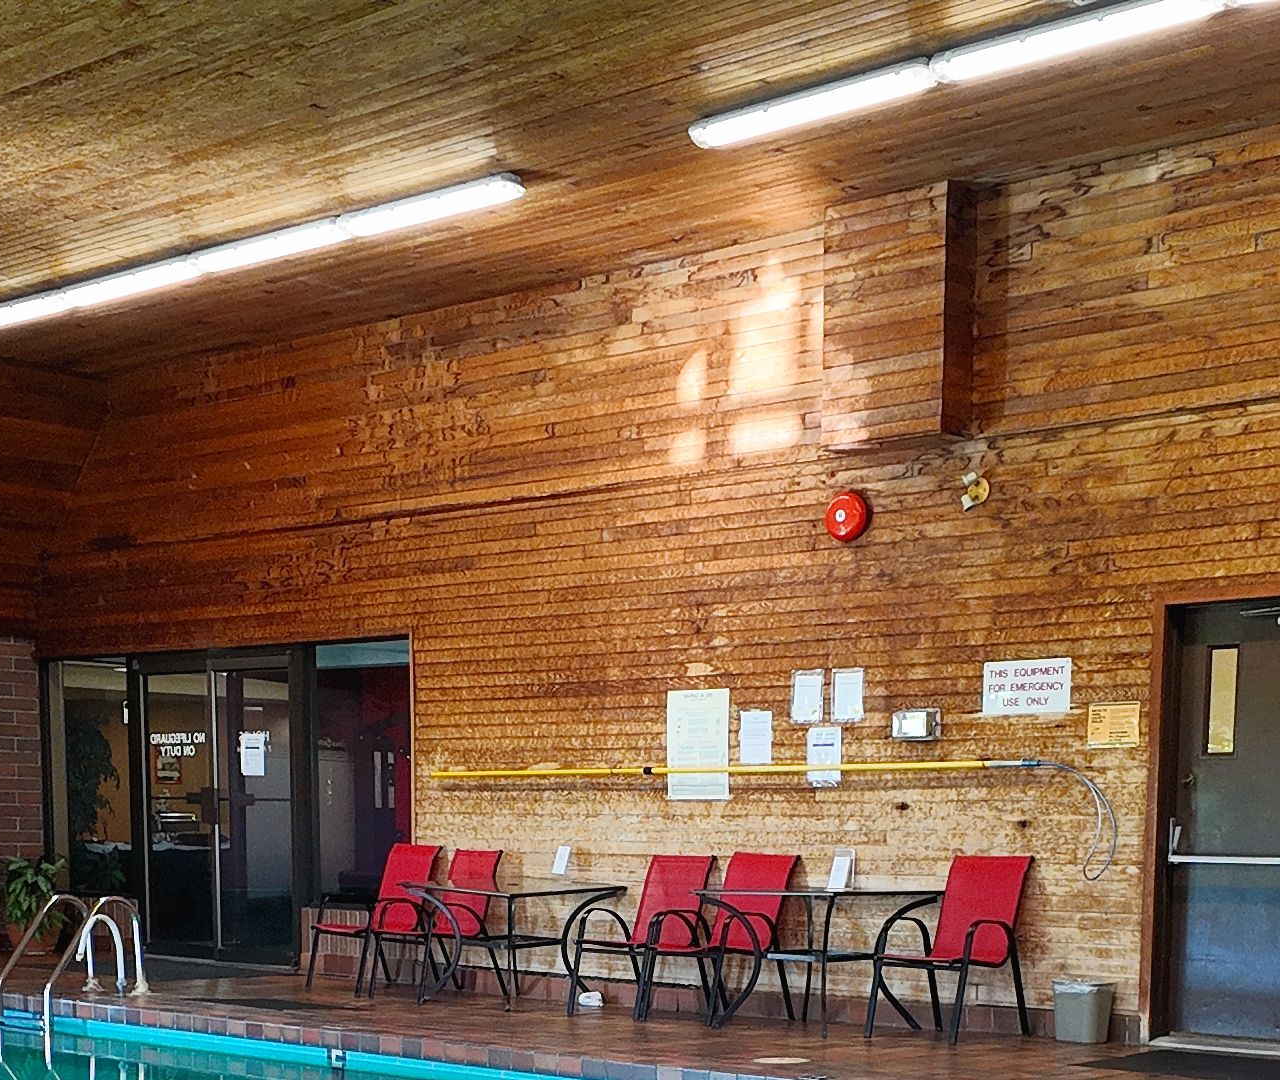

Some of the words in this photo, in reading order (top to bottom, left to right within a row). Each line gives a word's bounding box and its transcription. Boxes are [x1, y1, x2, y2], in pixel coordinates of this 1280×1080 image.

[989, 669, 1009, 678] THIS
[1014, 666, 1065, 677] EQUIPMENT
[988, 683, 1005, 692] FOR
[1010, 681, 1064, 691] EMERGENCY
[1003, 698, 1019, 707] USE
[1026, 696, 1049, 706] ONLY
